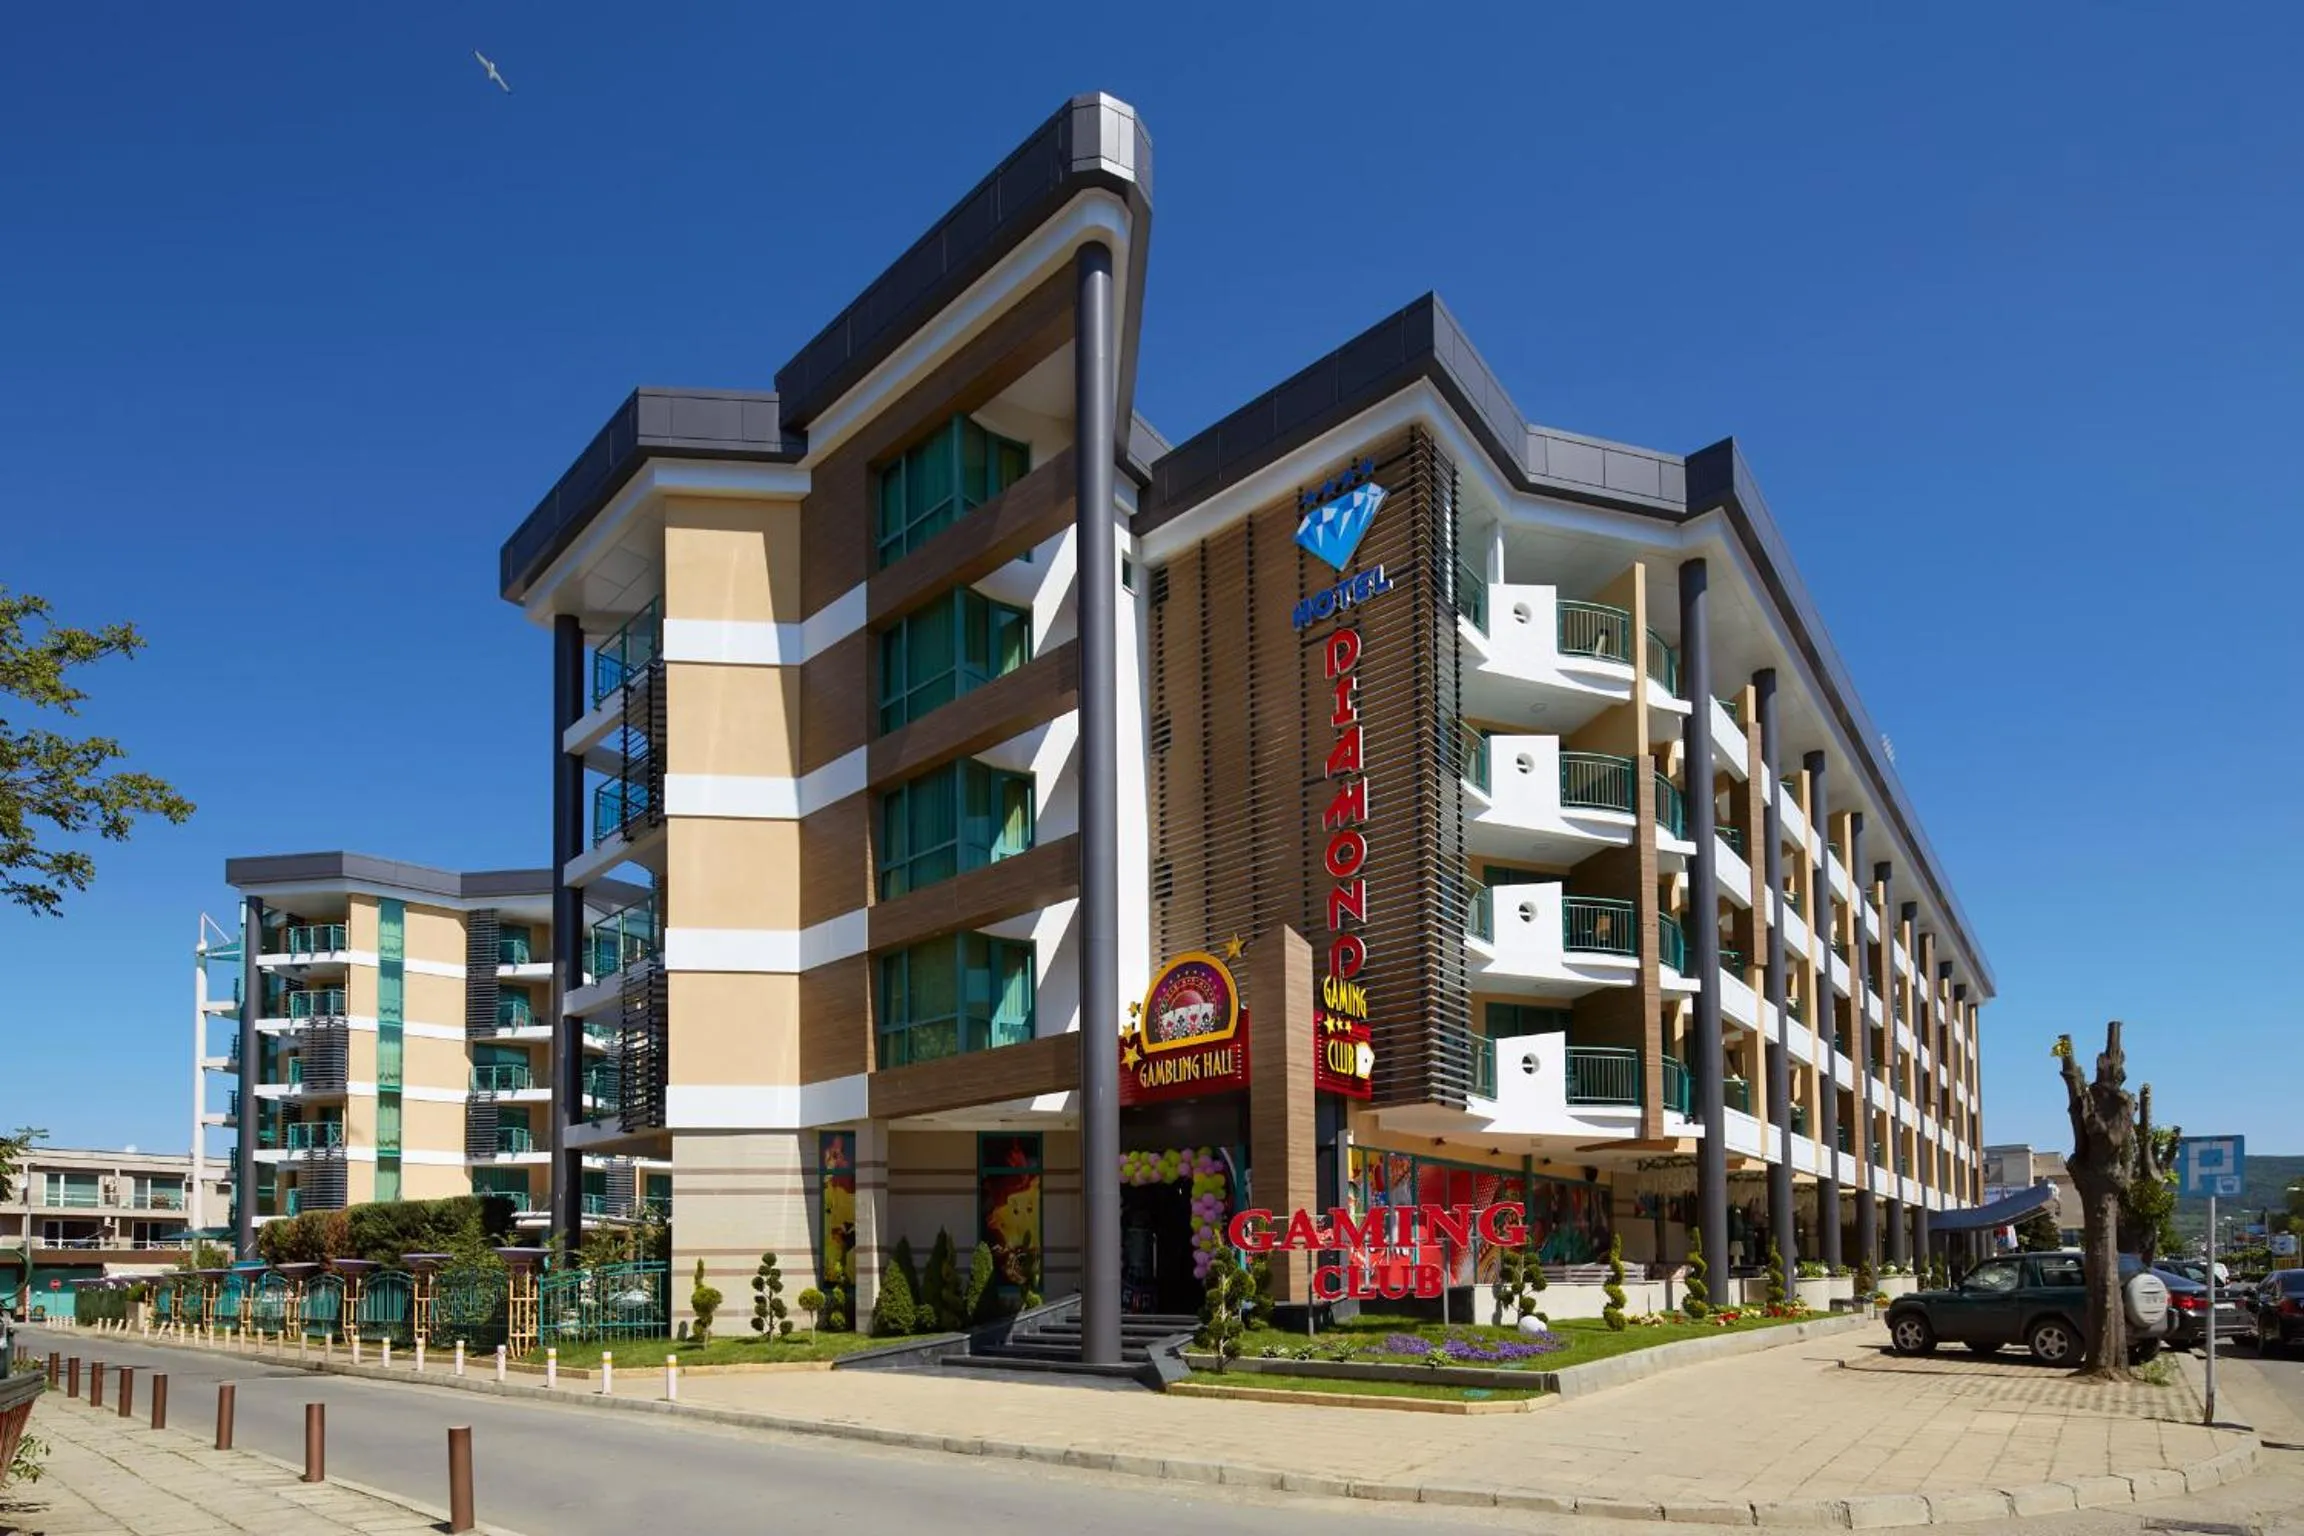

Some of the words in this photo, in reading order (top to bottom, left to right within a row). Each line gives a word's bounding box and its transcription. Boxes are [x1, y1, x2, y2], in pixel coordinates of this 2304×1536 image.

[1292, 564, 1394, 632] HOTEL
[1323, 628, 1368, 979] DIAMOND
[1323, 975, 1367, 1019] GAMING
[1139, 1053, 1200, 1089] GAMBLING
[1203, 1048, 1235, 1079] HALL
[1327, 1039, 1355, 1076] CLUB
[1228, 1202, 1529, 1251] GAMING
[1312, 1264, 1446, 1301] CLUB
